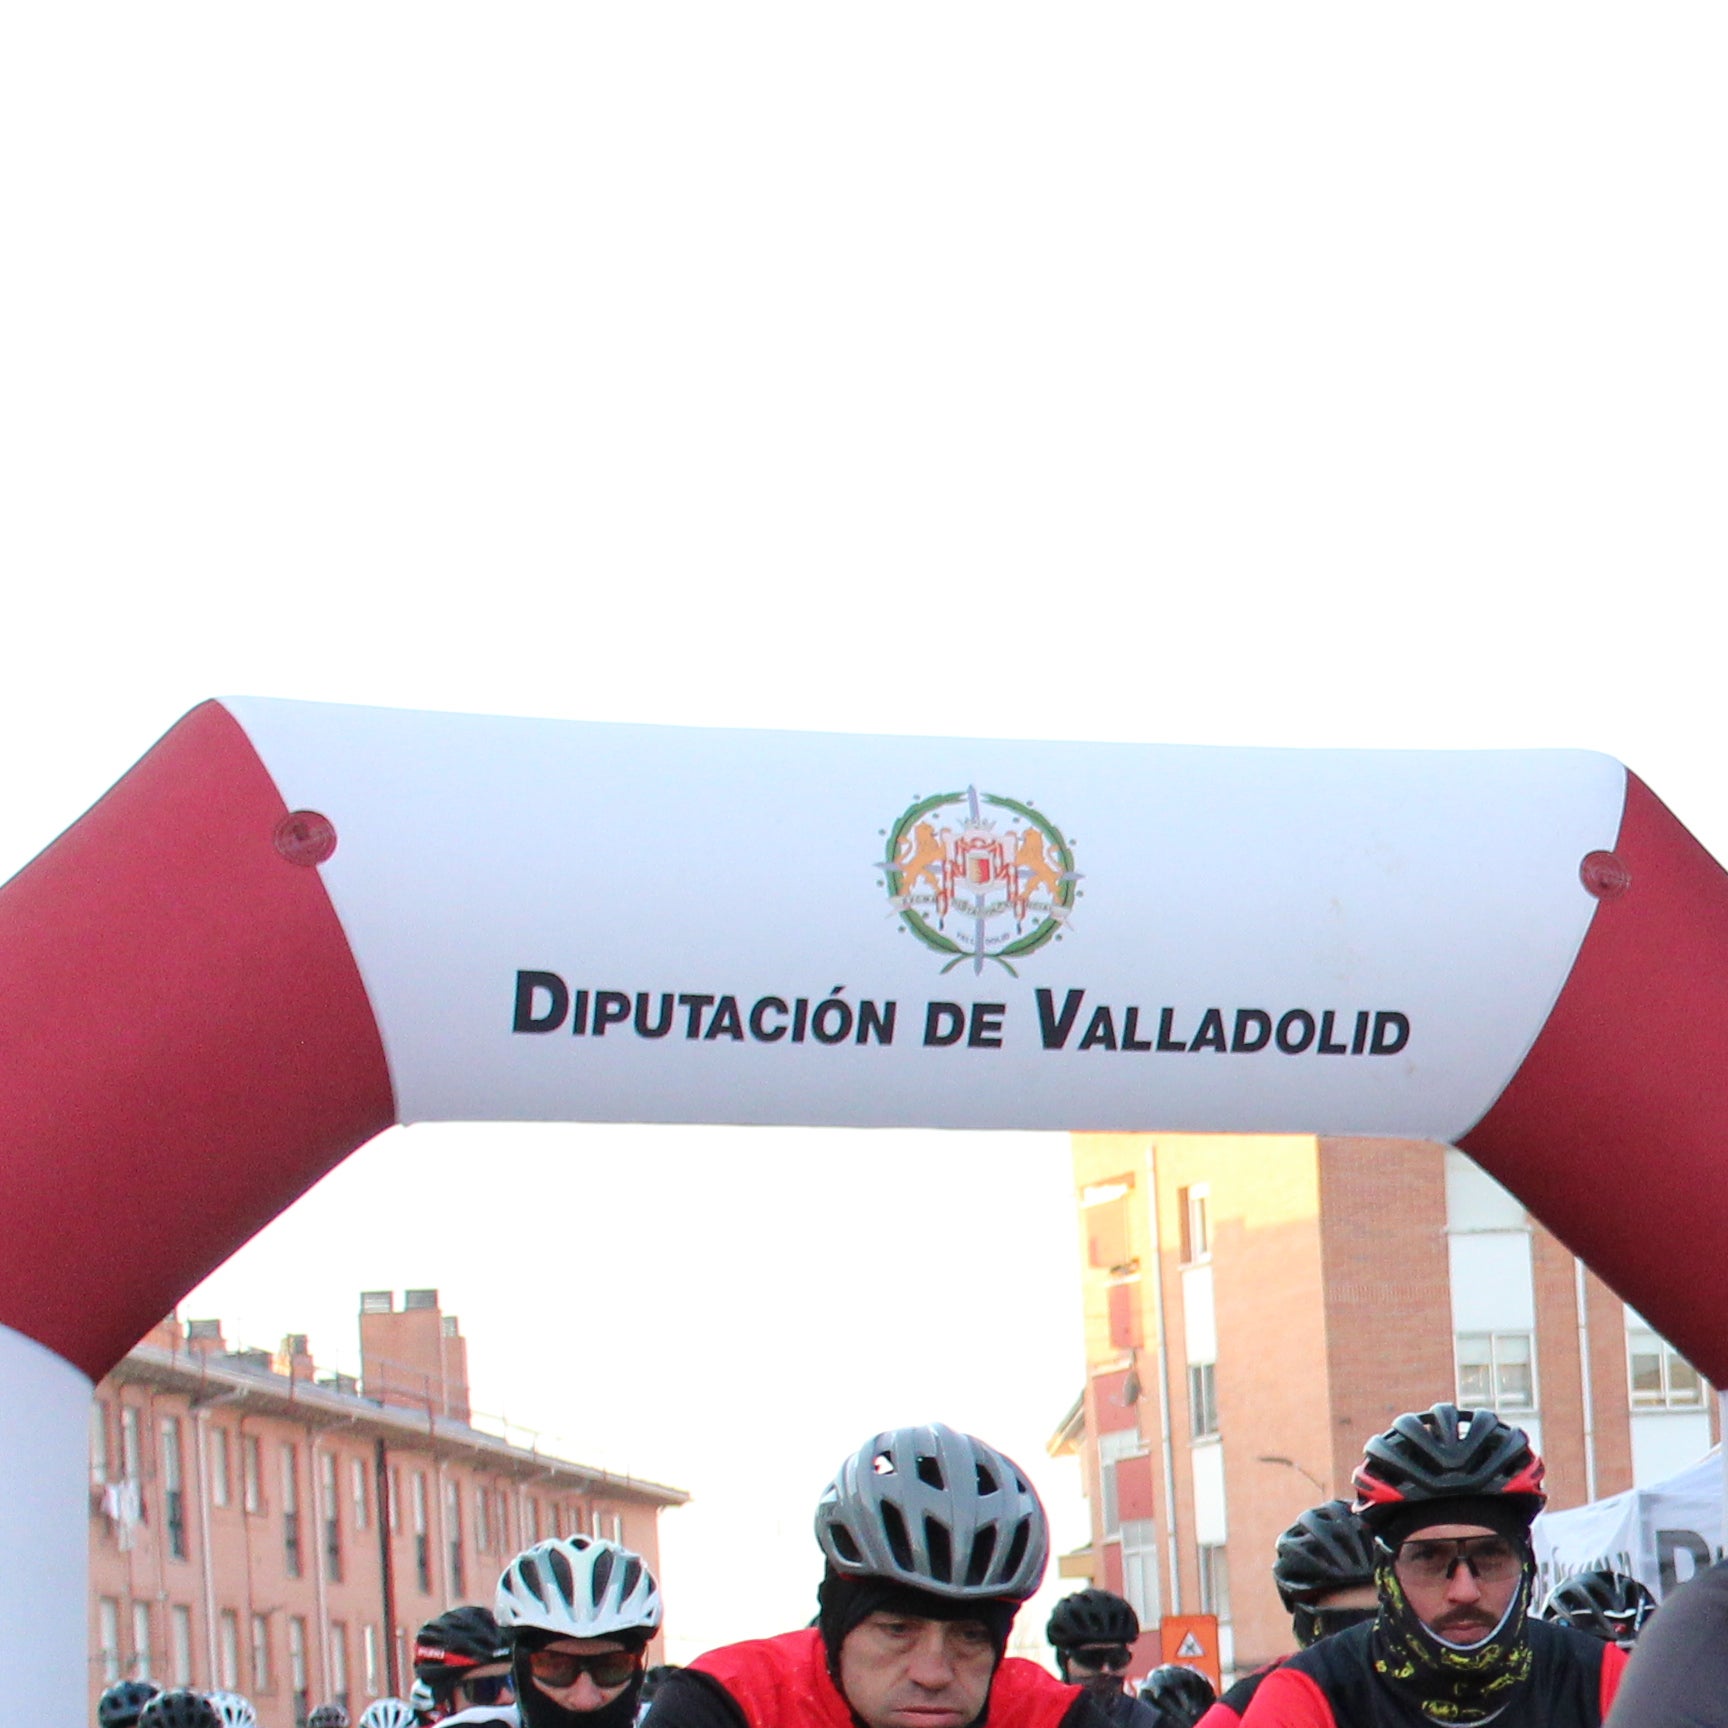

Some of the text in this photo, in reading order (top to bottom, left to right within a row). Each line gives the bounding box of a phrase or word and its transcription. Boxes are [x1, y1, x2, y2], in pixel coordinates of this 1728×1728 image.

[511, 969, 1412, 1056] DIPUTACIÓN DE VALLADOLID
